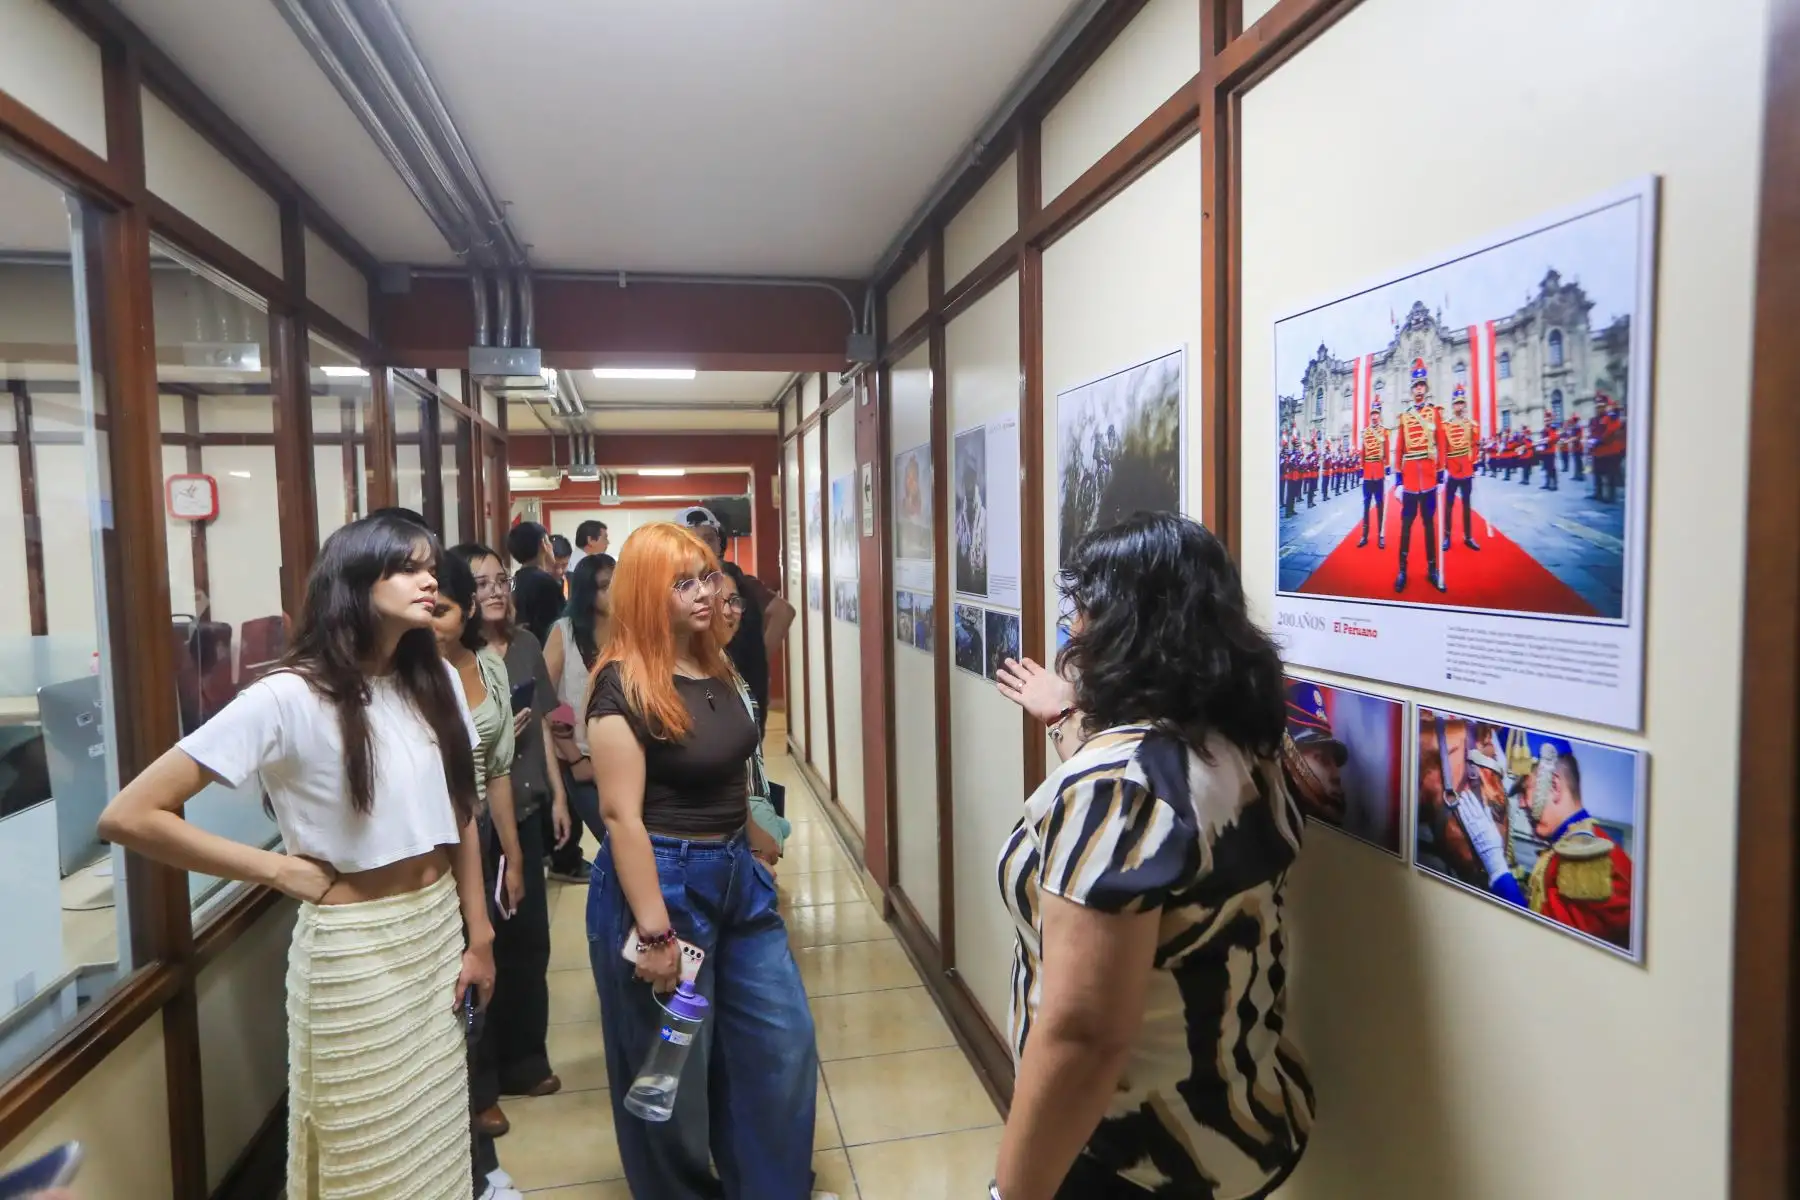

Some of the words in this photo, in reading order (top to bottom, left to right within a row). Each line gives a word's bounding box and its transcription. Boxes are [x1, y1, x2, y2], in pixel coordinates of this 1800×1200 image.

[1277, 611, 1295, 627] 200
[1297, 611, 1326, 631] AÑOS
[1334, 621, 1342, 633] El
[1343, 623, 1378, 638] Peruano
